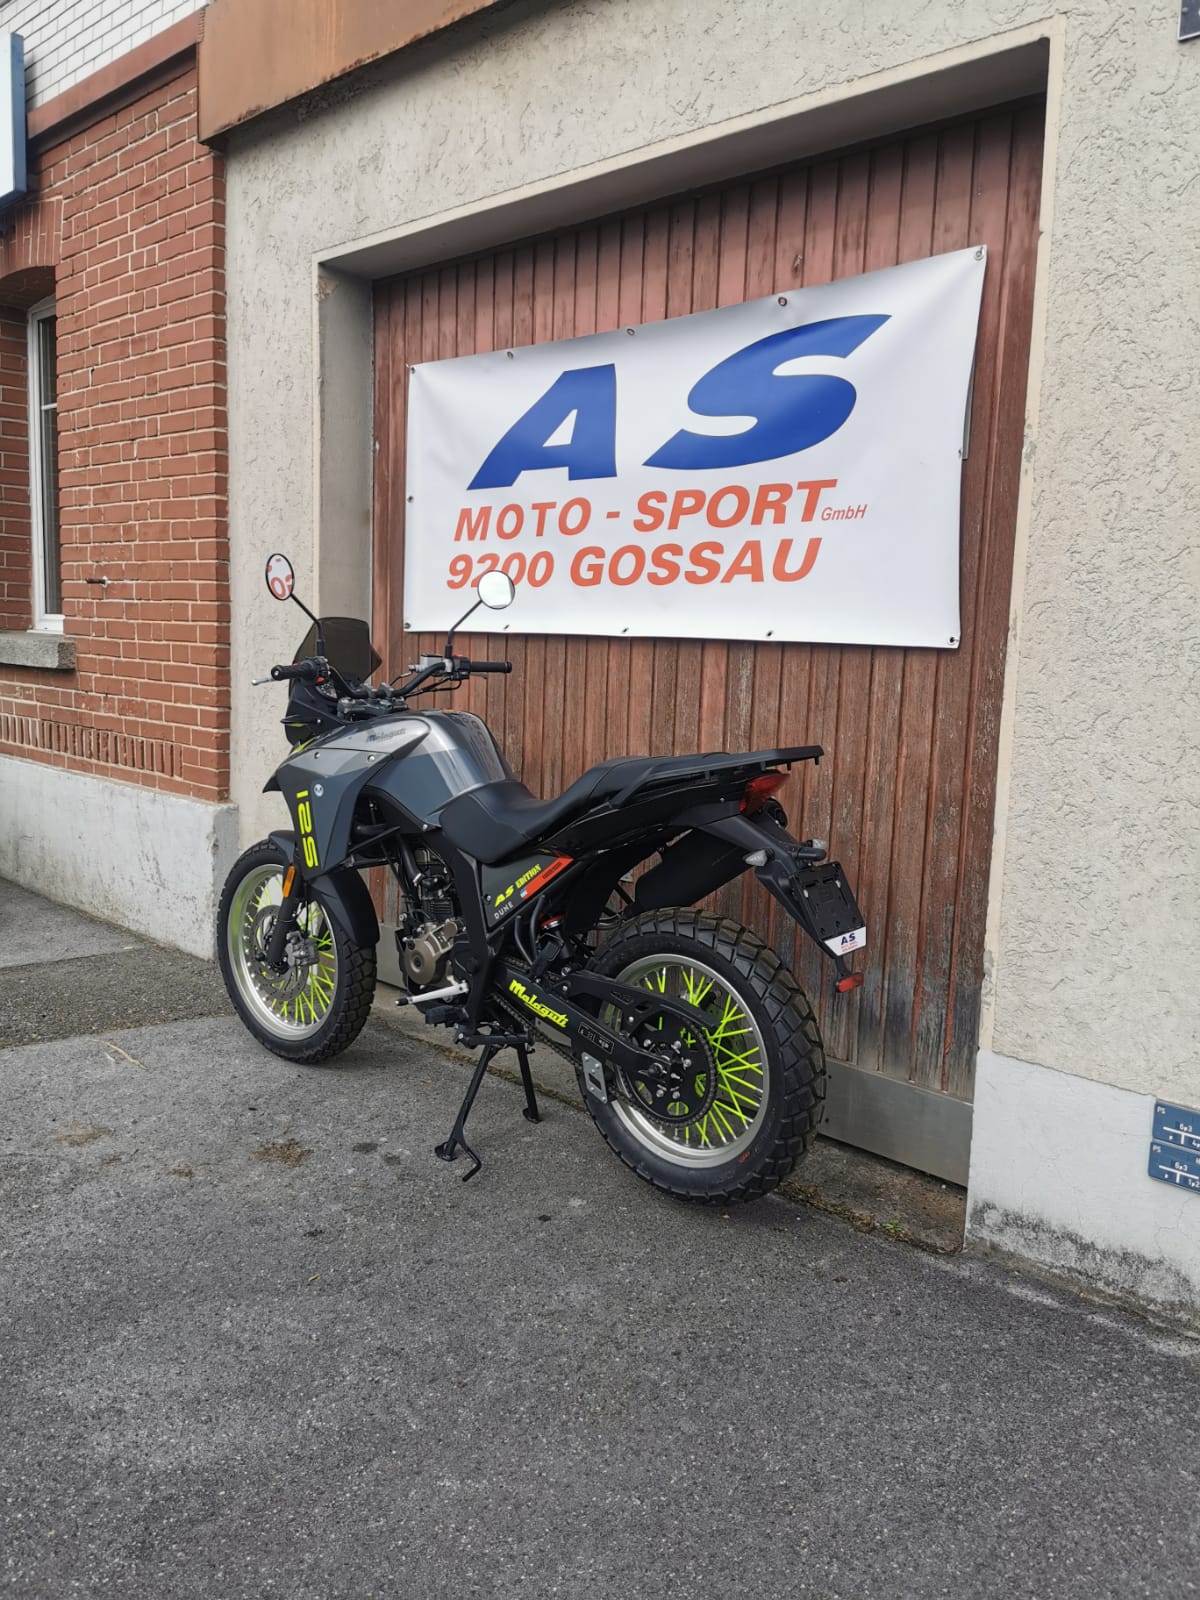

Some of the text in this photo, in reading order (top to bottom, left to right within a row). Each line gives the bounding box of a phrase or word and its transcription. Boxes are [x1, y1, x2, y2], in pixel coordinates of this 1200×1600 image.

[454, 497, 591, 542] MOTO
[633, 479, 837, 532] SPORT
[821, 503, 867, 521] GmbH
[447, 538, 822, 589] 9200 GOSSAU
[515, 863, 541, 888] EDITION
[494, 901, 514, 919] DUNE
[841, 933, 856, 945] AS
[509, 979, 568, 1028] Malaguti
